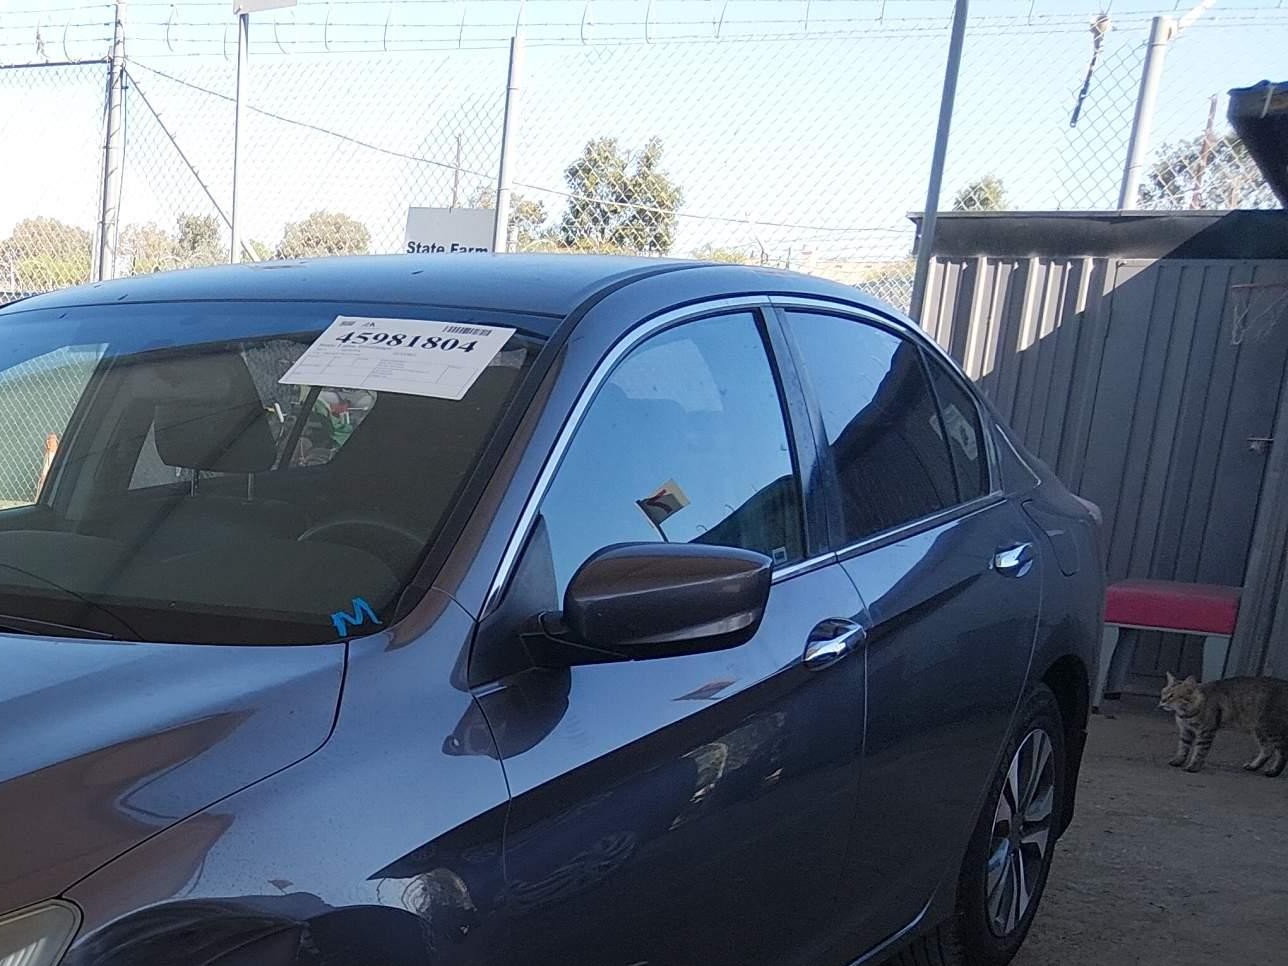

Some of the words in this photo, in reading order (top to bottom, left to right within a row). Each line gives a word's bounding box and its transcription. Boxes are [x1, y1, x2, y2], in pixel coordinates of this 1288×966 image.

[406, 240, 445, 254] State
[336, 330, 478, 353] 45981804
[330, 597, 383, 637] M
